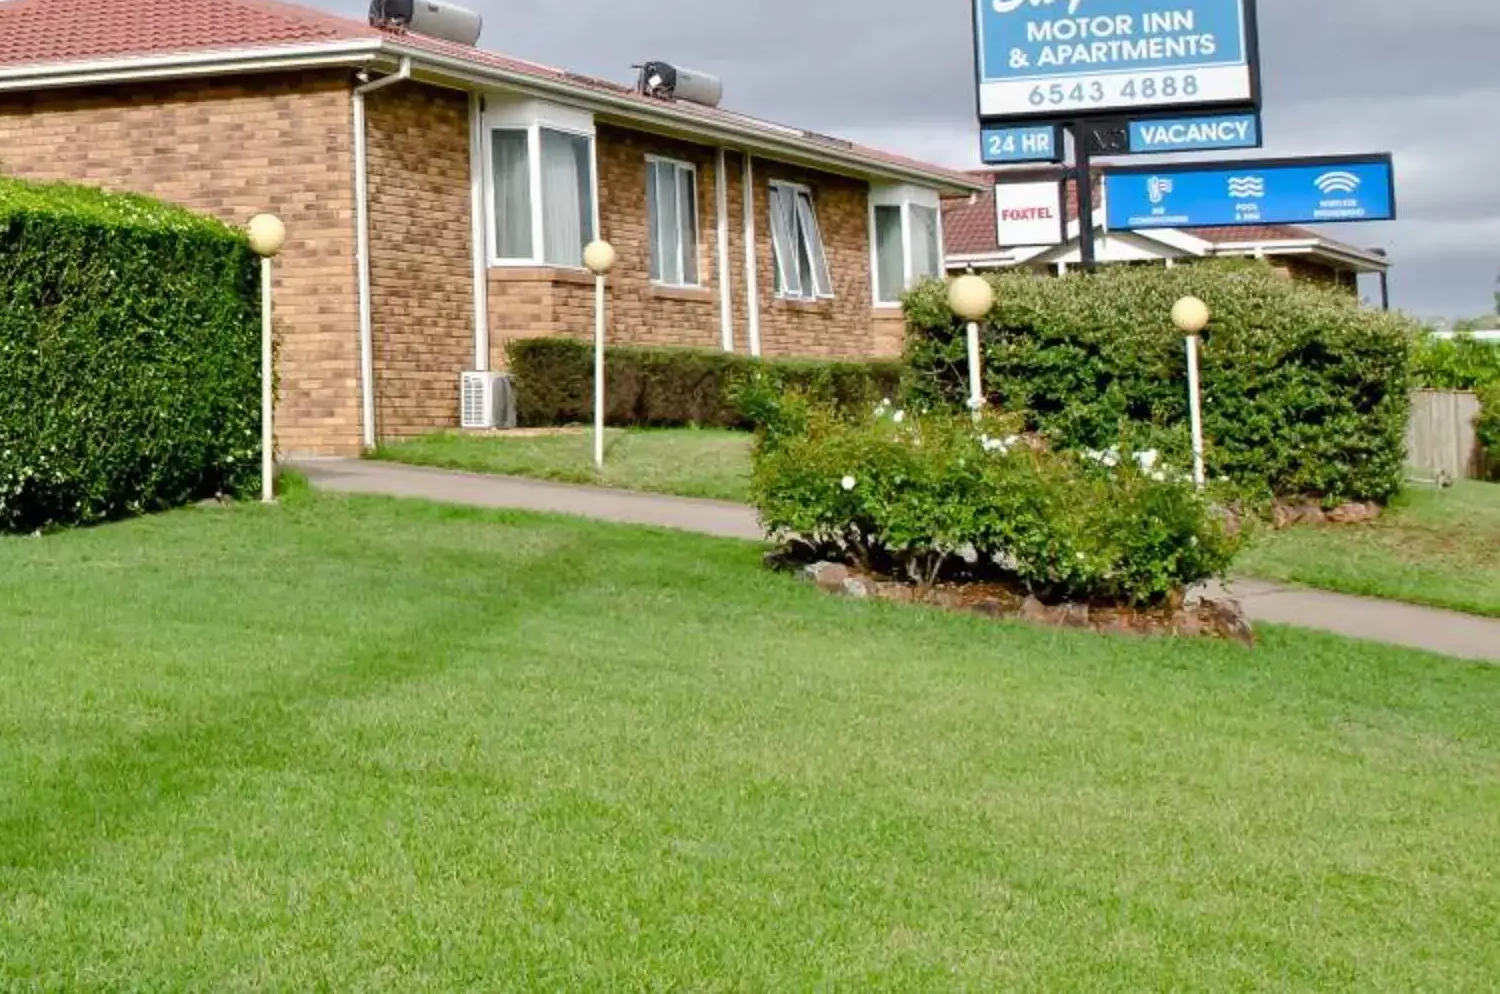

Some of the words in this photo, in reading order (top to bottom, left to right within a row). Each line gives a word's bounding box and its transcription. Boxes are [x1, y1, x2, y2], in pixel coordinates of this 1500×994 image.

[1027, 15, 1132, 43] MOTOR
[1143, 10, 1193, 32] INN
[1008, 48, 1029, 69] &
[1037, 34, 1216, 67] APARTMENTS
[1028, 81, 1105, 107] 6543
[1120, 75, 1198, 99] 4888
[989, 136, 1015, 155] 24
[1022, 133, 1049, 151] HR
[1139, 121, 1249, 144] VACANCY
[1001, 207, 1053, 221] FOXTEL
